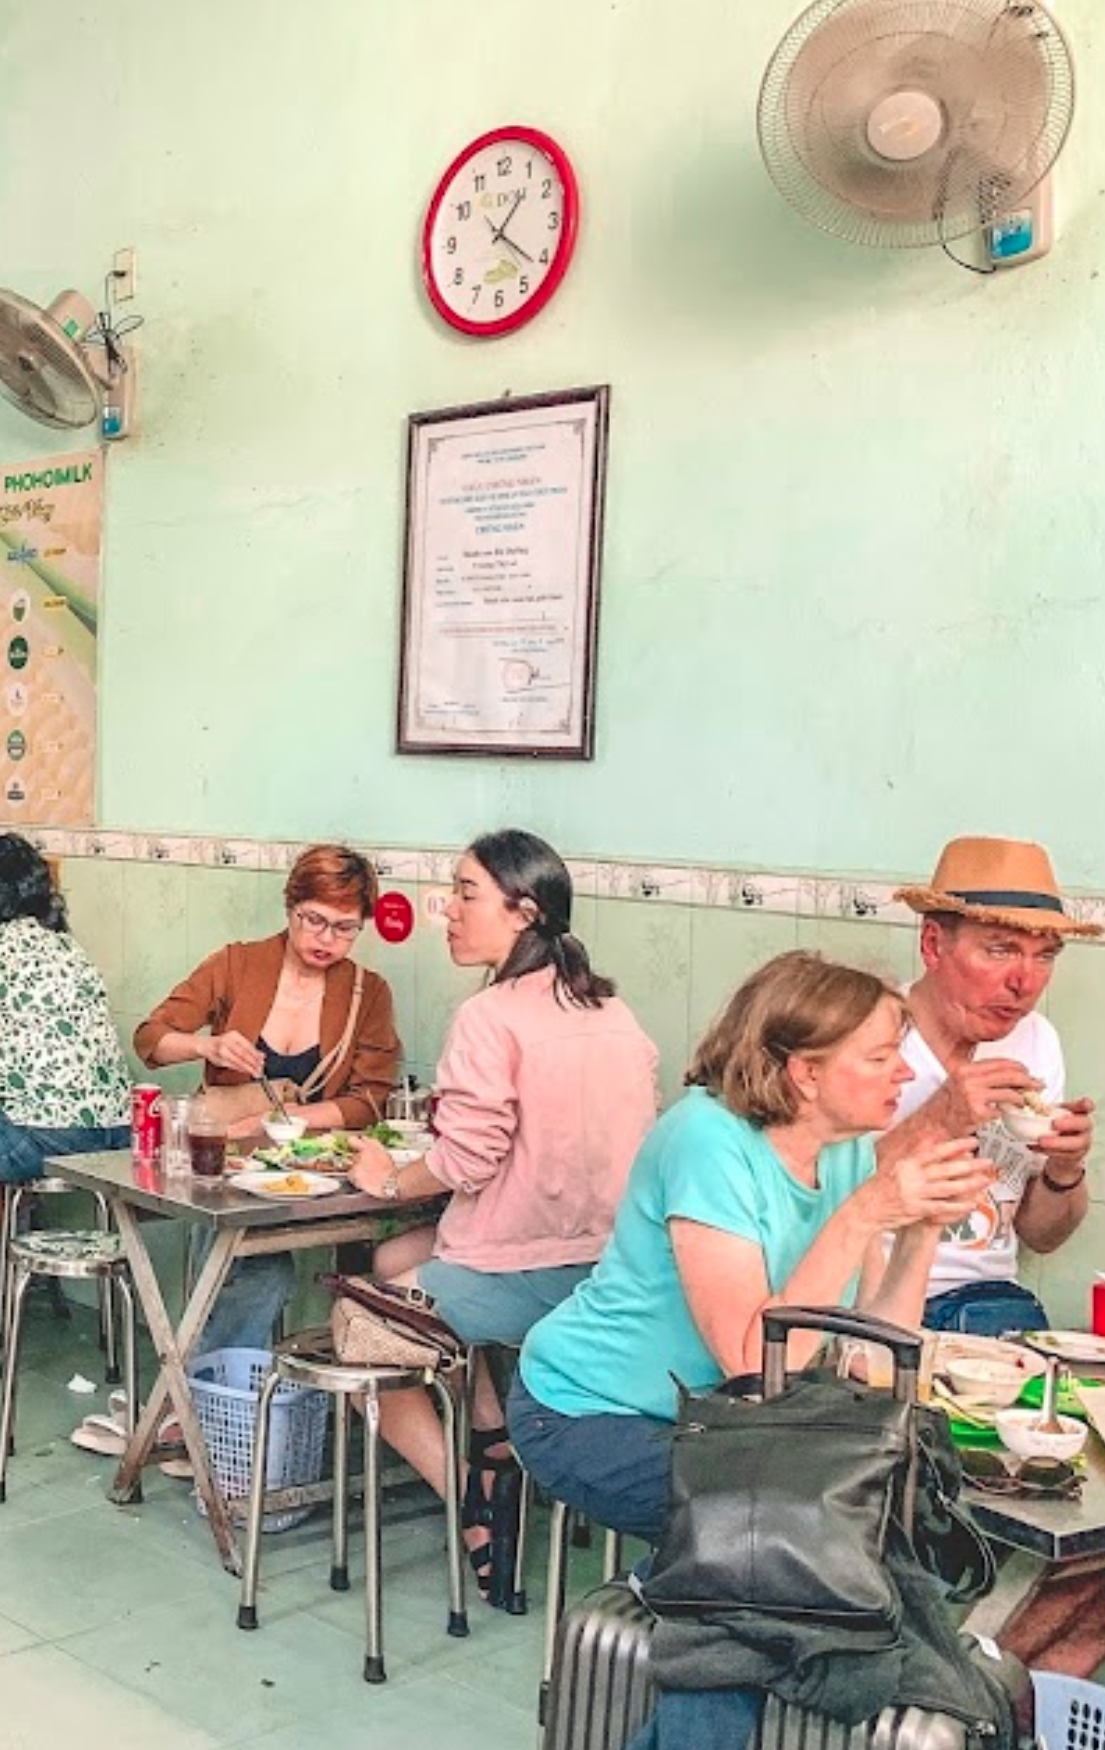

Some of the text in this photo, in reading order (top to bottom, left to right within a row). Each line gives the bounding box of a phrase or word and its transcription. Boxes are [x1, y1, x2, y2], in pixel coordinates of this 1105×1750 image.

[496, 156, 512, 176] 12
[525, 161, 532, 178] 1
[473, 174, 486, 192] 11
[541, 178, 552, 199] 2
[456, 201, 471, 221] 10
[547, 211, 558, 230] 3
[447, 236, 457, 254] 9
[538, 249, 549, 265] 4
[454, 267, 464, 286] 8
[519, 275, 529, 294] 5
[472, 285, 482, 304] 7
[494, 290, 504, 308] 6
